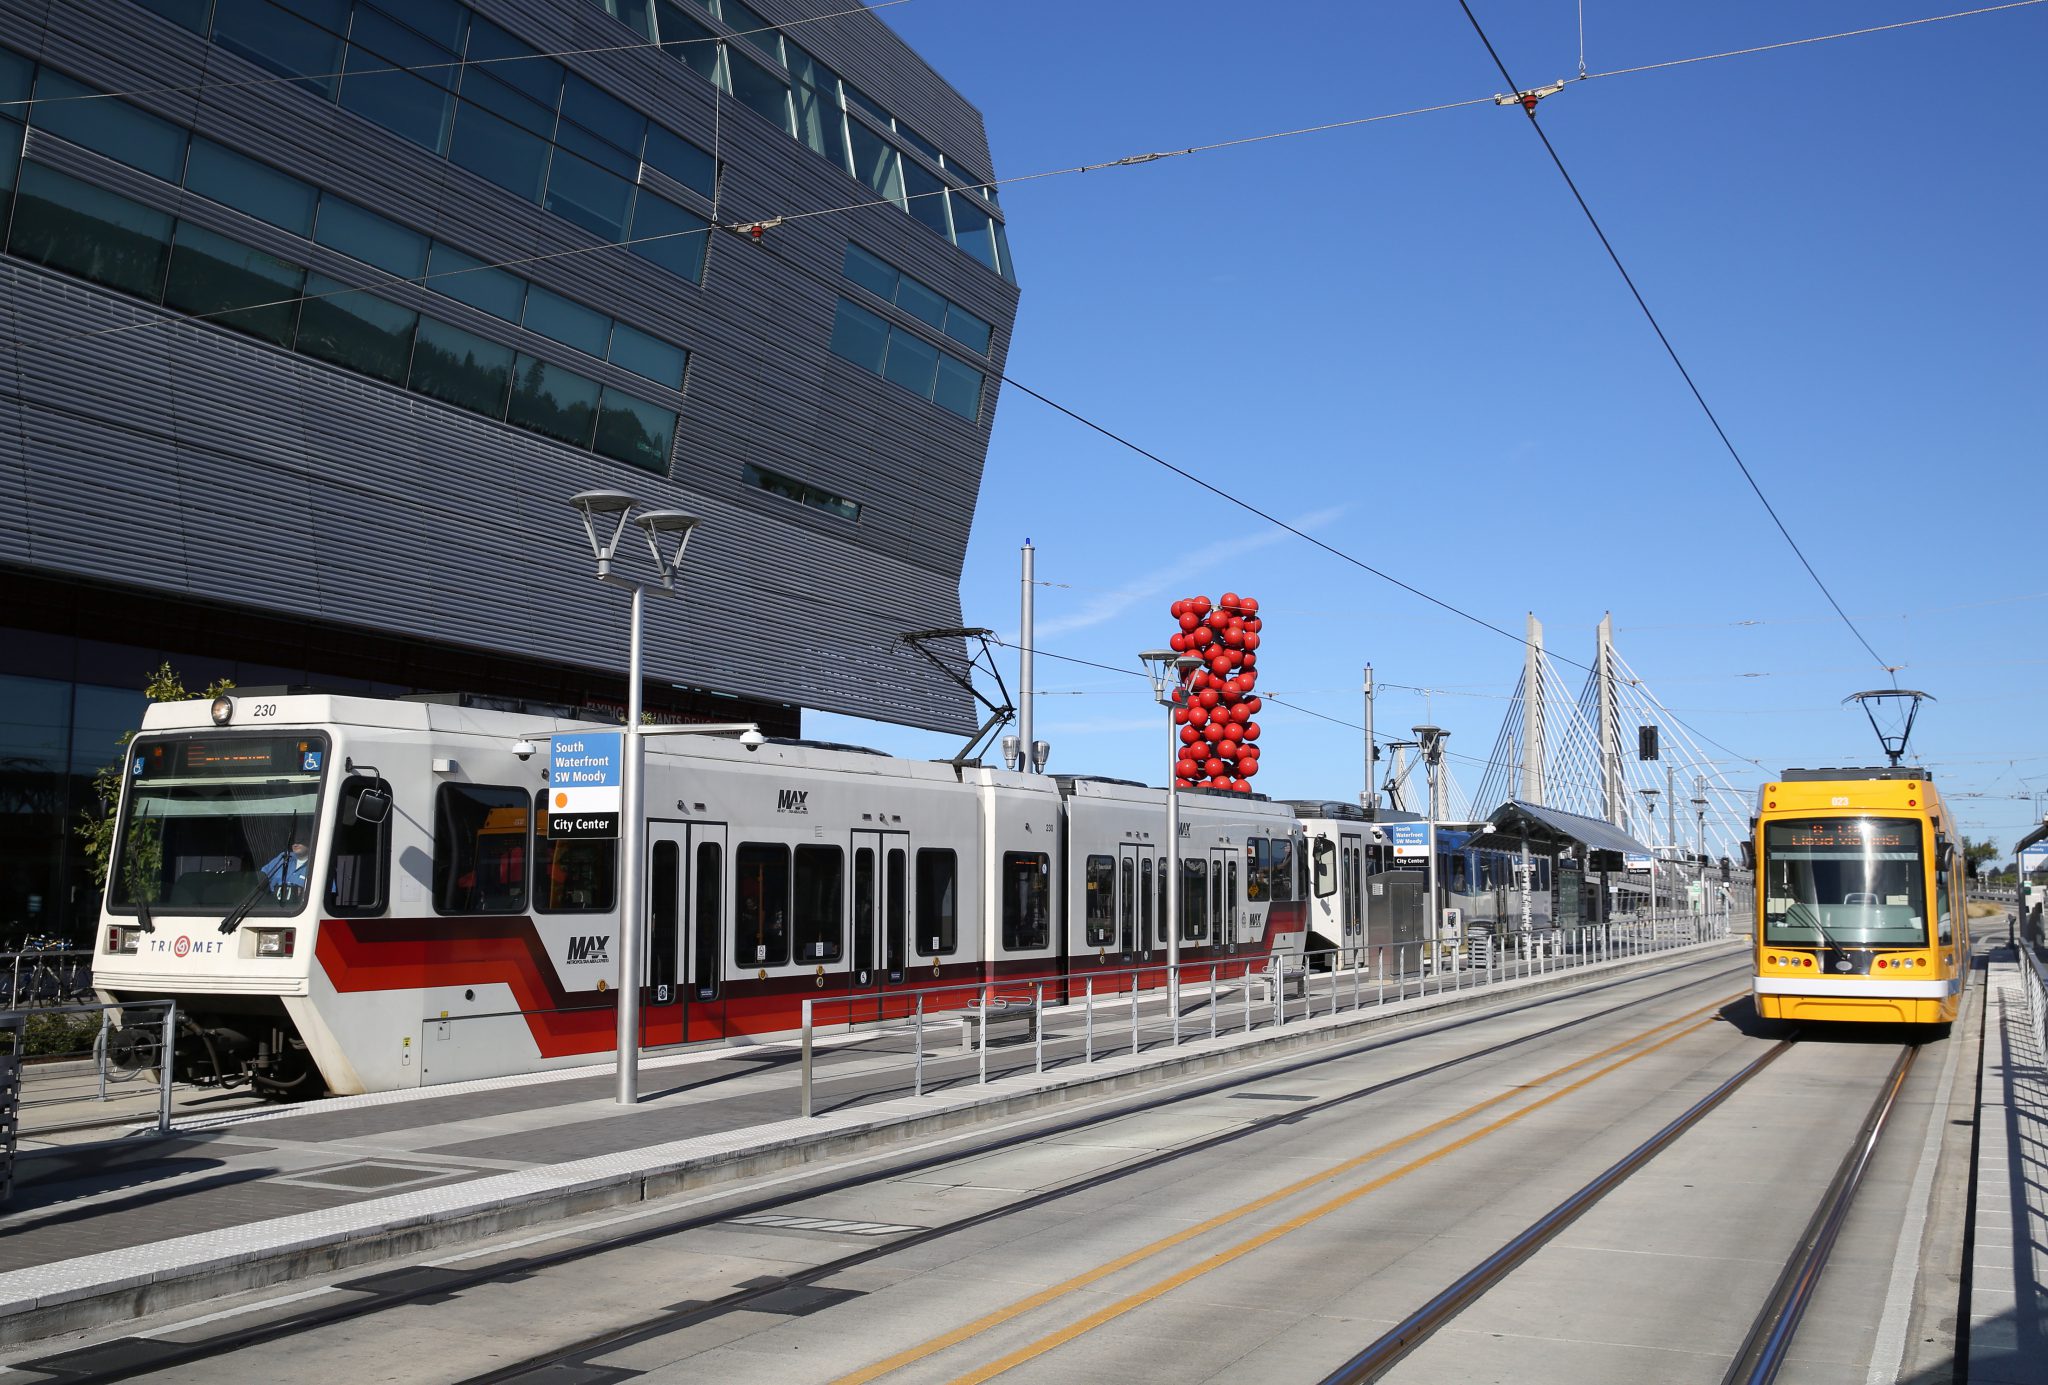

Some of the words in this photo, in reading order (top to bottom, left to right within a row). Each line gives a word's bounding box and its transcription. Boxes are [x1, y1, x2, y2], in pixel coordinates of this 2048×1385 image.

[253, 704, 277, 717] 230
[555, 741, 584, 753] South
[555, 756, 609, 768] Waterfront
[555, 772, 570, 783] SW
[573, 770, 607, 784] Moody
[777, 789, 809, 811] MAX
[553, 818, 573, 833] City
[576, 818, 610, 830] Center
[567, 935, 610, 960] MAX
